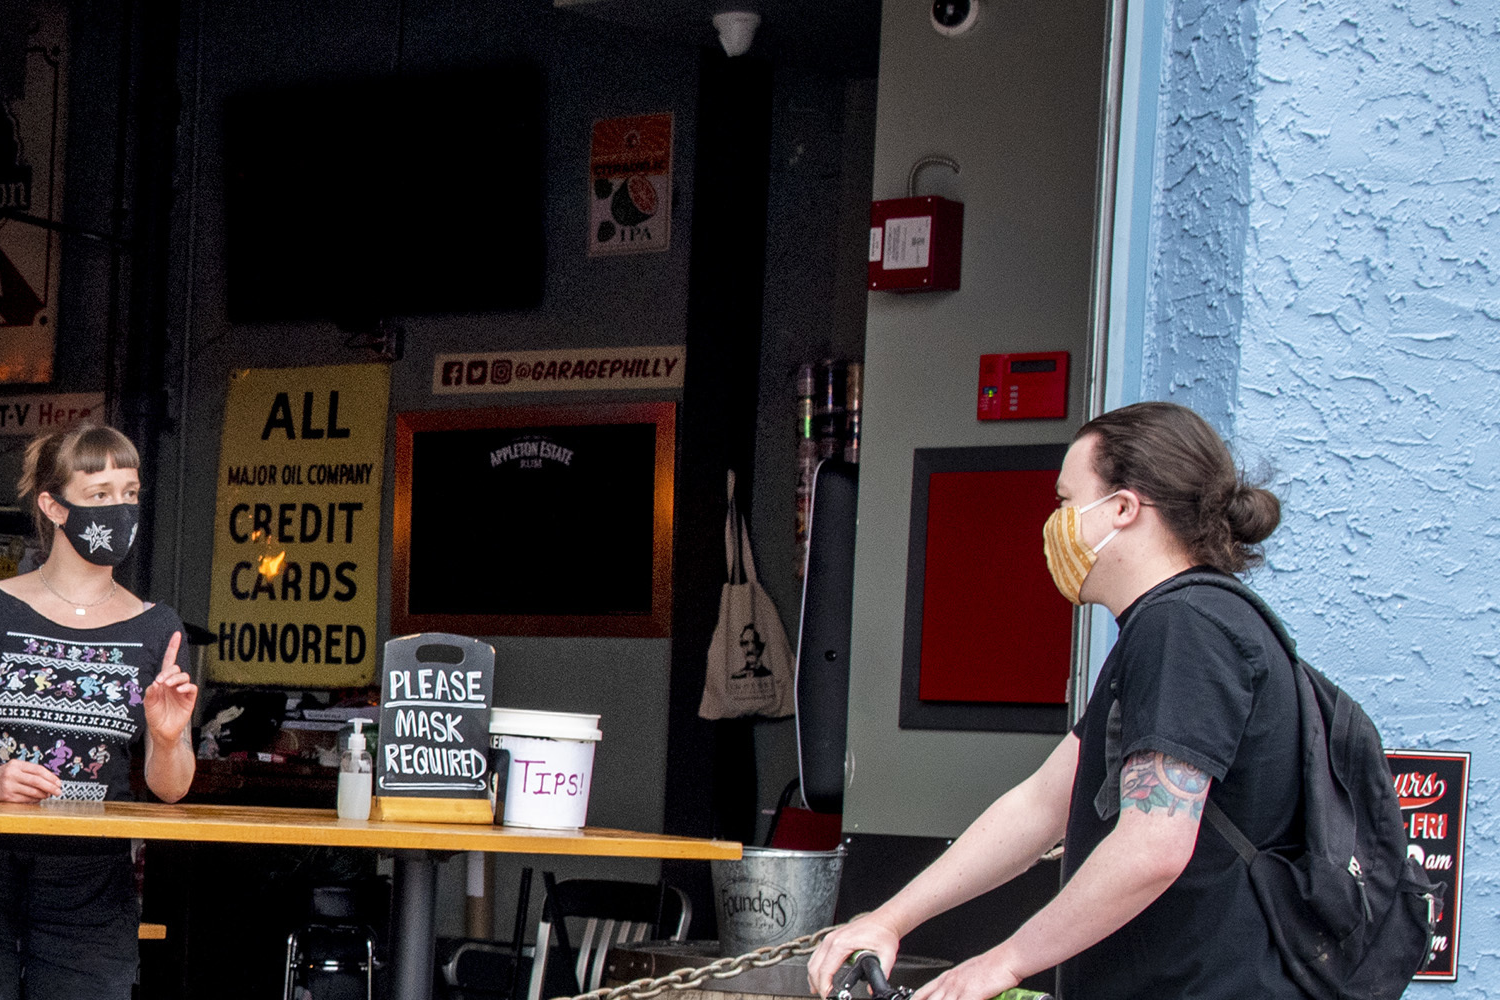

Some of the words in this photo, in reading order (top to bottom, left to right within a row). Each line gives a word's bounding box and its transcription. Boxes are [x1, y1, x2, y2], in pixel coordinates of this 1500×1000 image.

[619, 226, 652, 242] IPA
[515, 357, 679, 382] @GARAGEPHILLY
[261, 390, 351, 441] ALL
[489, 441, 539, 468] APPLETON
[539, 440, 575, 466] ESTATE
[227, 464, 277, 486] MAJOR
[282, 464, 303, 486] OIL
[307, 462, 374, 486] COMPANY
[229, 502, 363, 544] CREDIT
[230, 560, 358, 602] CARDS
[219, 621, 367, 665] HONORED
[389, 668, 486, 701] PLEASE
[395, 709, 464, 743] MASK
[384, 743, 488, 780] REQUIRED
[1409, 813, 1449, 840] FRI
